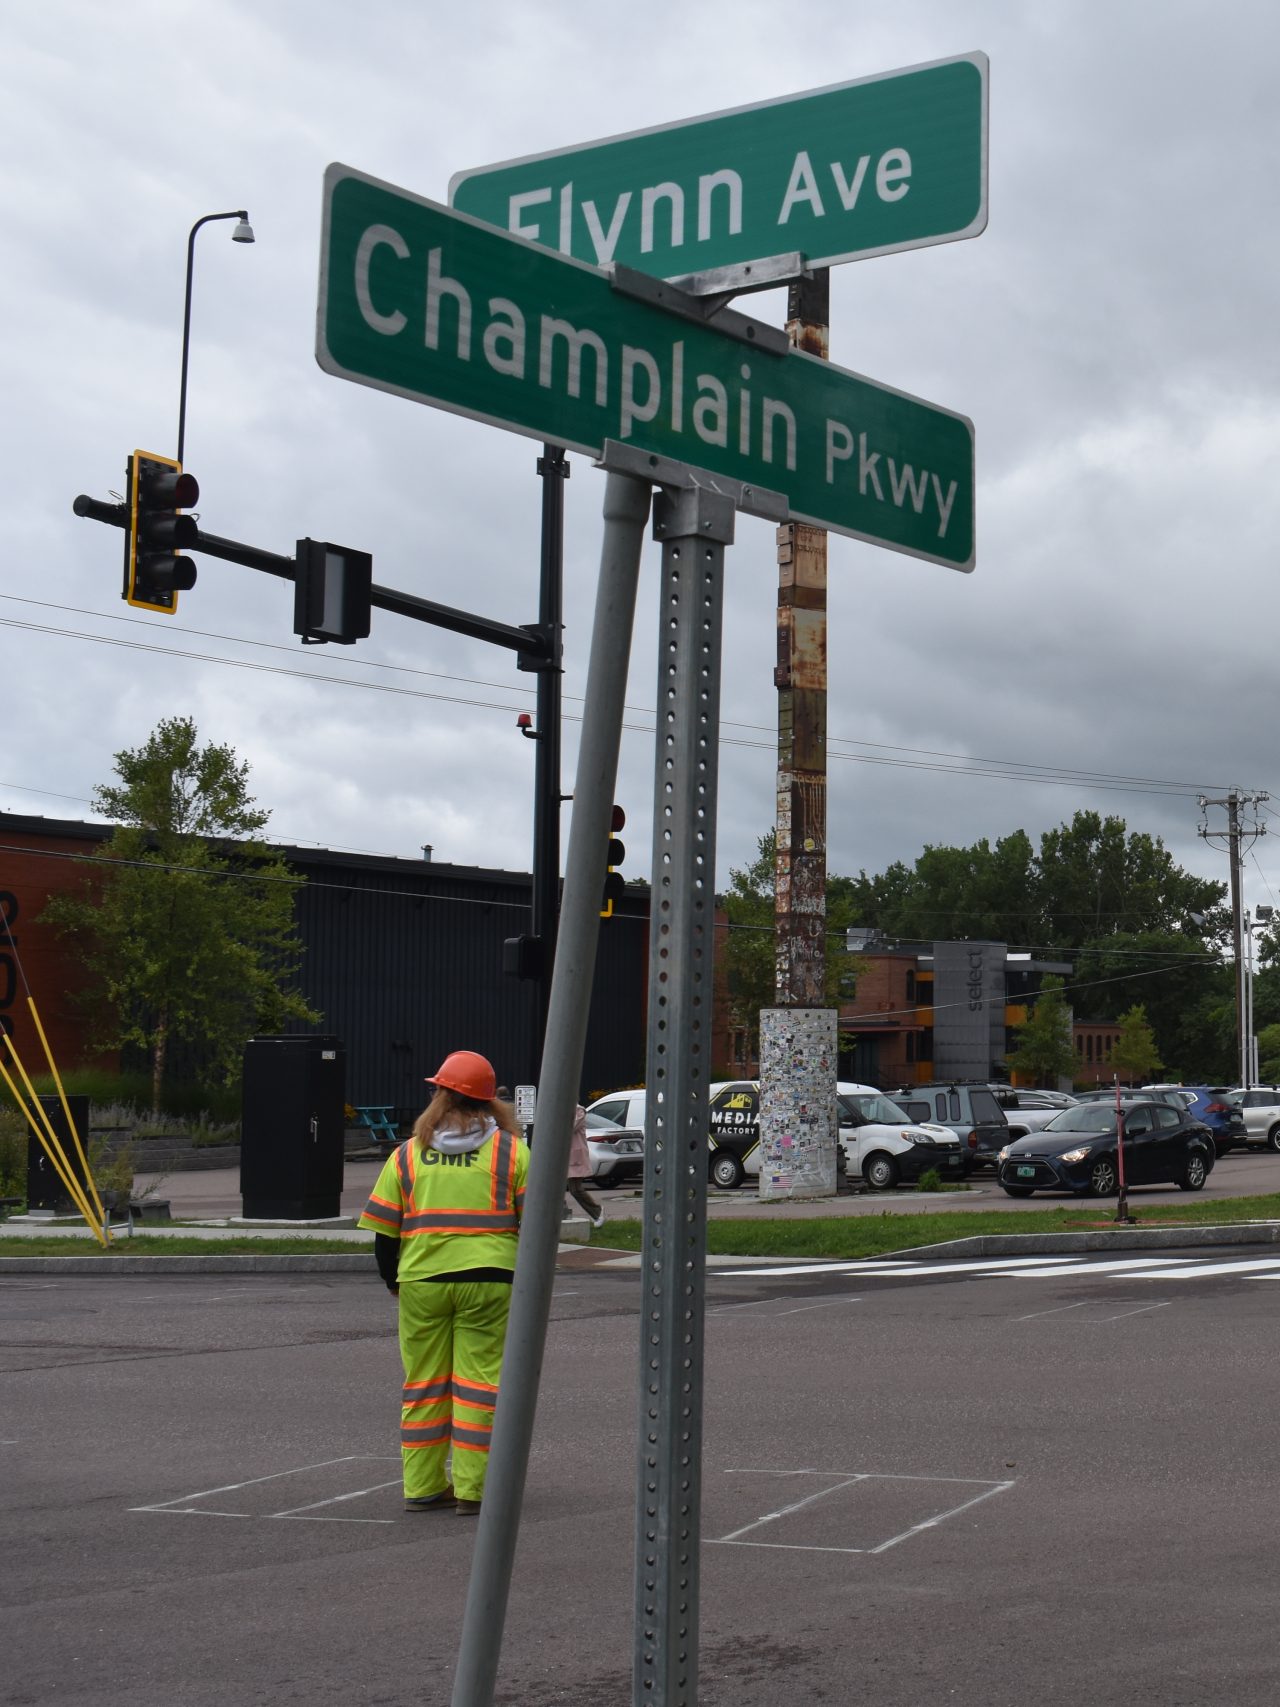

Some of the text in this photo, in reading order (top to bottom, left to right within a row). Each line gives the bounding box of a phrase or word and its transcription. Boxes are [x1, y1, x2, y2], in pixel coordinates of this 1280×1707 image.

[508, 146, 913, 266] Flynn Ave
[353, 222, 958, 538] Champlain Pkwy
[966, 948, 983, 1012] select
[711, 1111, 760, 1125] MEDIA
[717, 1126, 755, 1134] FACTORY
[420, 1147, 480, 1167] GMF
